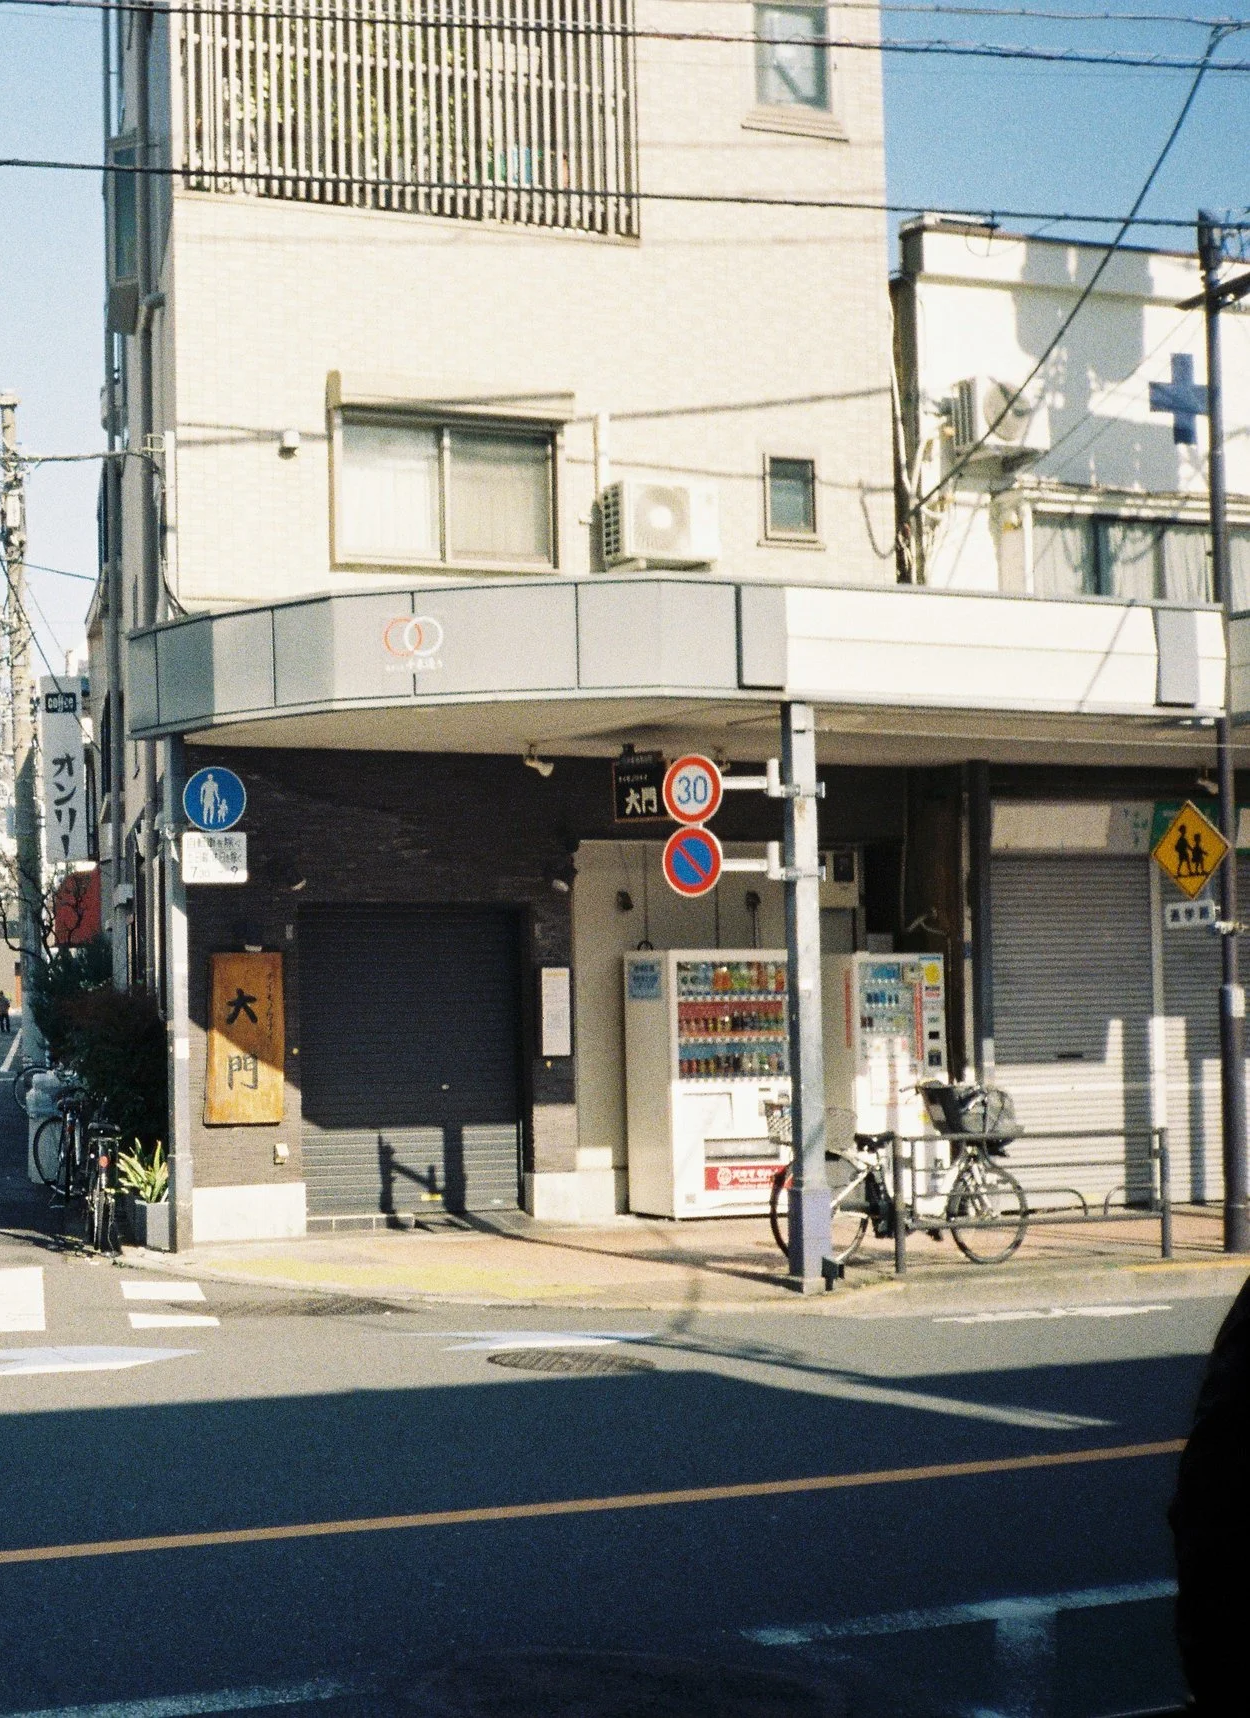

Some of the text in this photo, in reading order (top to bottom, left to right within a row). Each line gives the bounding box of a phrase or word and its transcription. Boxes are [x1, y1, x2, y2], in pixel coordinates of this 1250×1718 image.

[47, 695, 74, 712] coffee
[625, 786, 658, 815] 大門
[678, 775, 708, 805] 30
[52, 752, 77, 859] オンリー
[225, 987, 259, 1091] 大門
